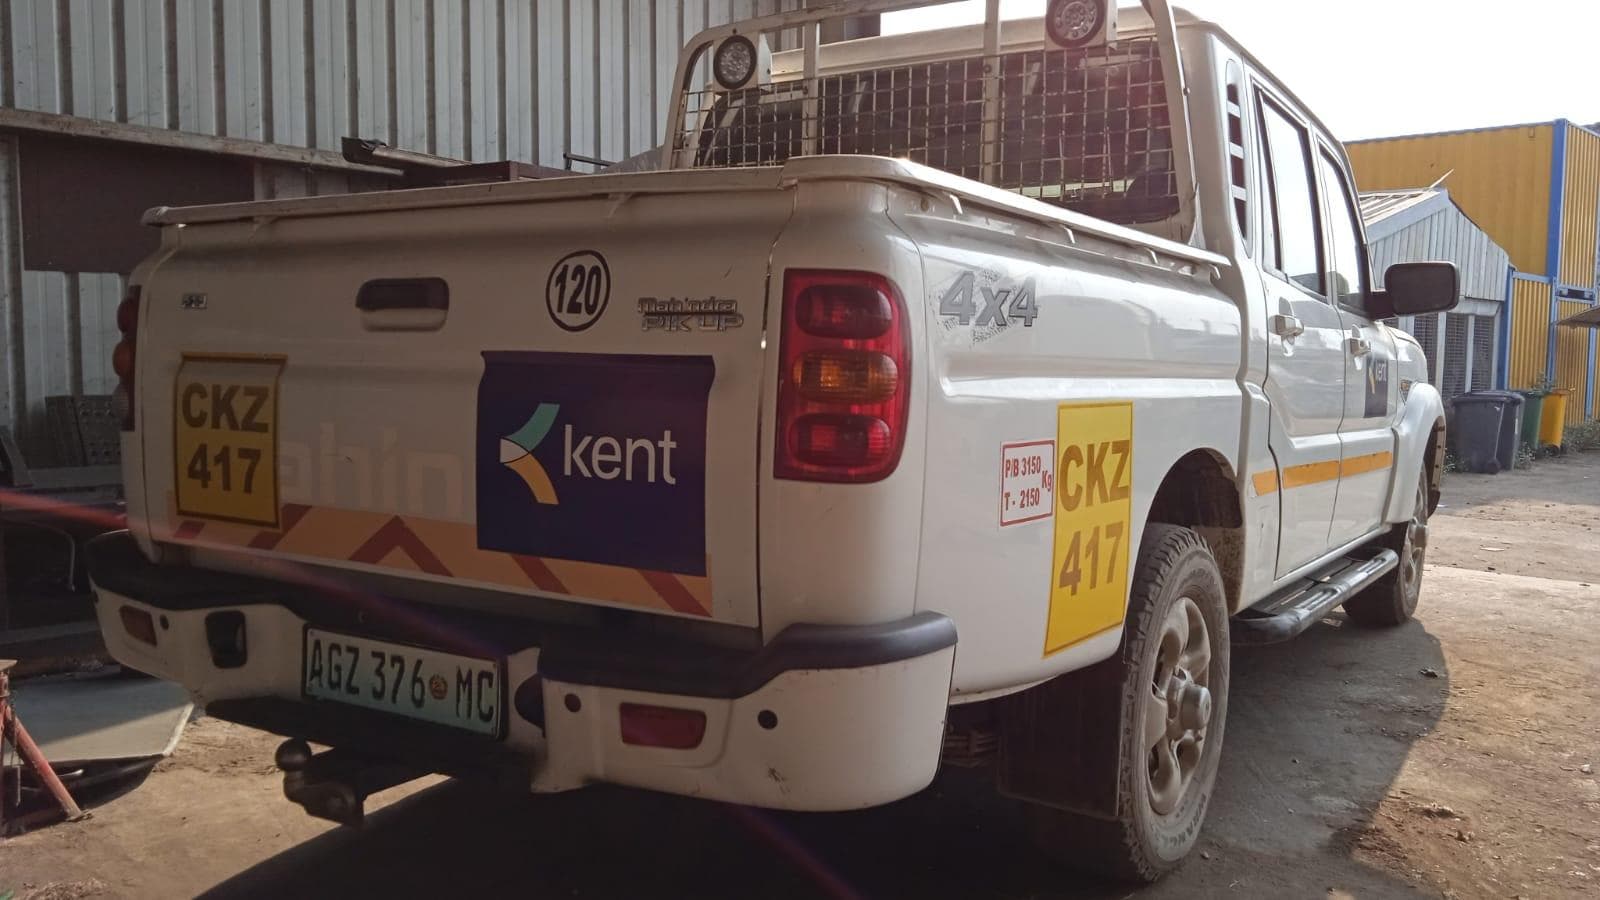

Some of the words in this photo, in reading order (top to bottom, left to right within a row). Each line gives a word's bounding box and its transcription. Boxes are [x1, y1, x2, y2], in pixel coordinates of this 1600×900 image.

[554, 264, 601, 316] 120
[939, 270, 1039, 327] 4x4
[181, 382, 270, 434] CKZ
[187, 443, 262, 494] 417
[563, 423, 677, 485] kent
[1020, 454, 1042, 477] 3150
[1059, 439, 1131, 513] CKZ
[1019, 487, 1041, 509] 2150
[1041, 469, 1053, 492] Kg
[1058, 520, 1125, 598] 417
[308, 638, 360, 696] AGZ
[370, 650, 426, 709] 376
[455, 664, 495, 723] MC
